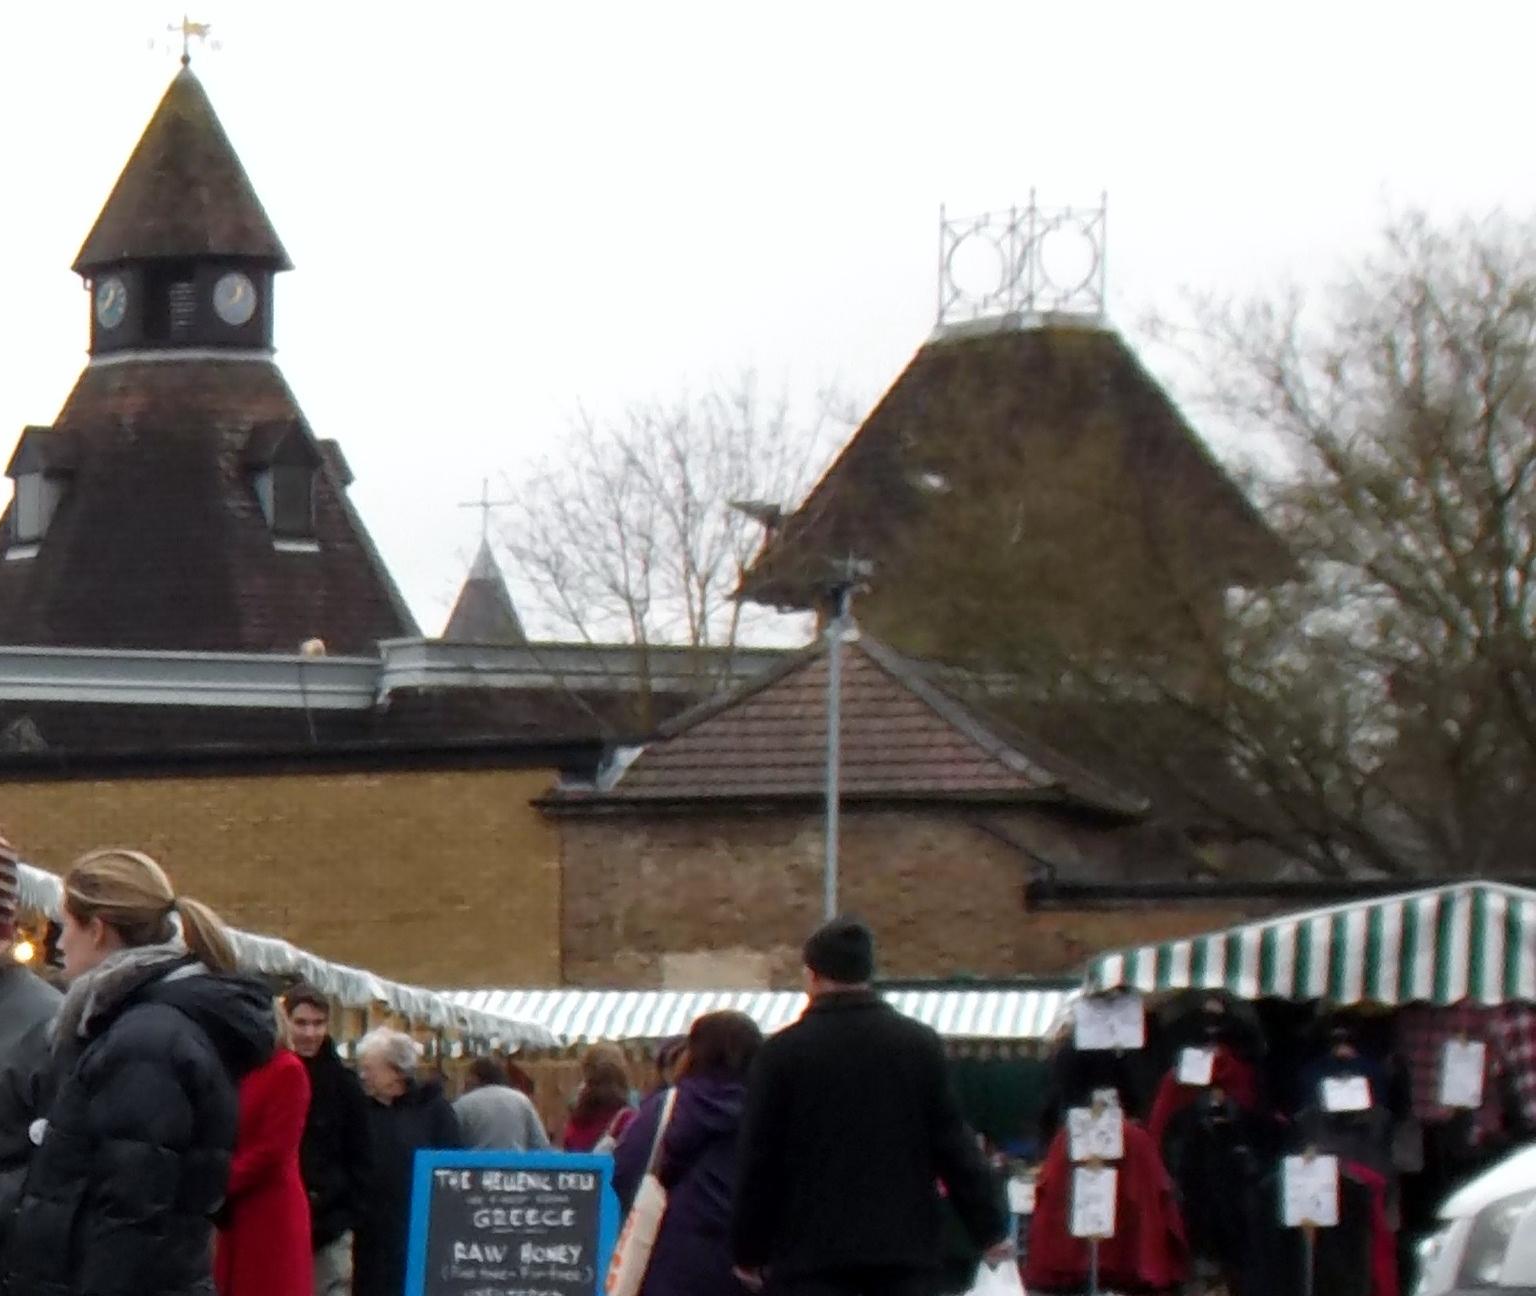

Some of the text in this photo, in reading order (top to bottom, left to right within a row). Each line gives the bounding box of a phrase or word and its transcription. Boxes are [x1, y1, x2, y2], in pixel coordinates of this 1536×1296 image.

[434, 1169, 472, 1190] THE
[473, 1209, 576, 1228] GREECE
[454, 1242, 584, 1264] RAW HONEY
